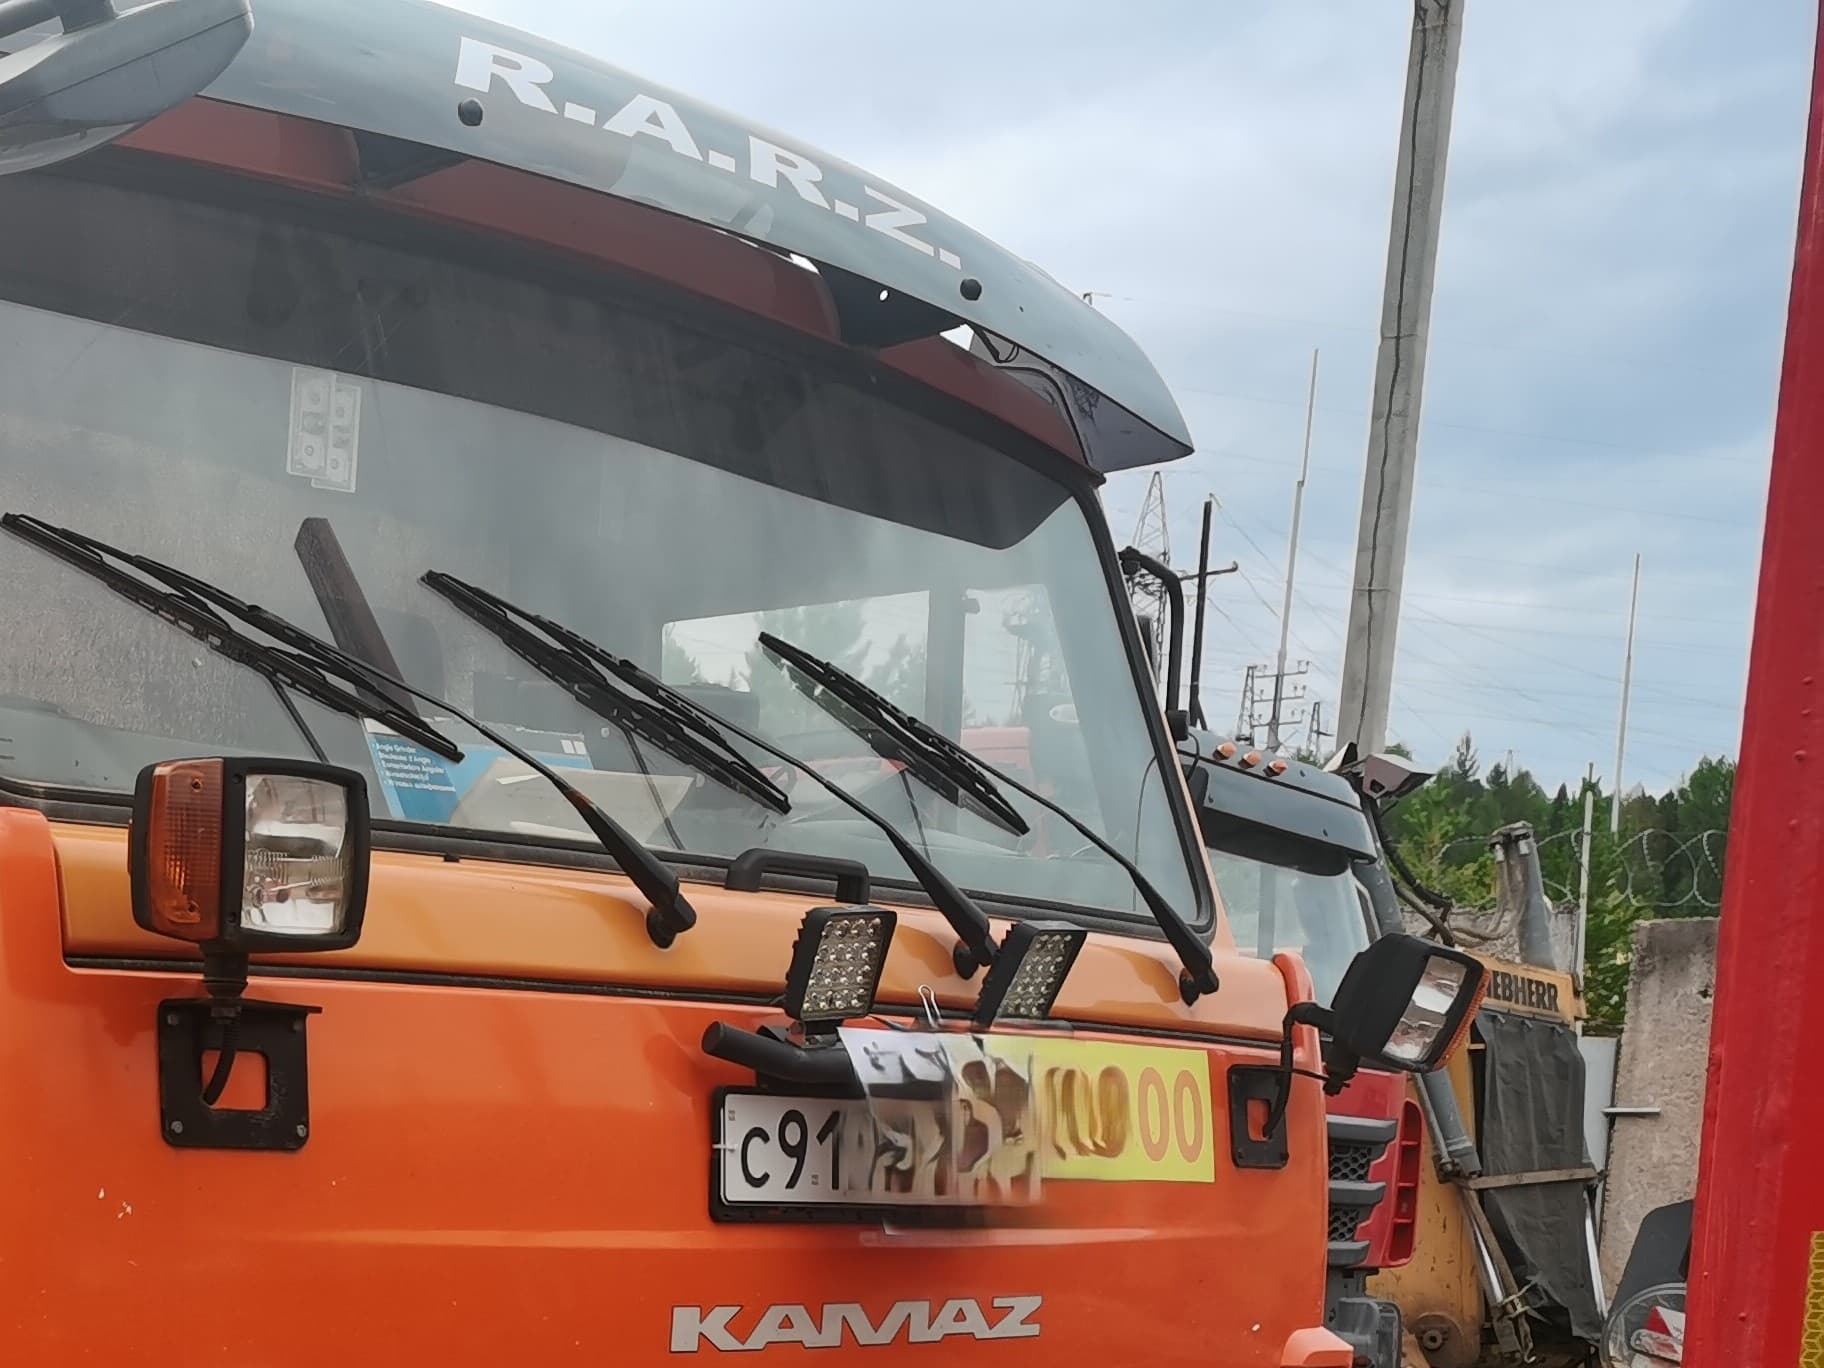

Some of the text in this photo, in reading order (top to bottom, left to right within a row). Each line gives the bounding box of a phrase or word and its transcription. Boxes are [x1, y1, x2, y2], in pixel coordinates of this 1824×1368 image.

[453, 35, 963, 271] R.A.R.Z.
[1487, 970, 1560, 1013] IEBHERR
[669, 1294, 1043, 1353] KAMAZ
